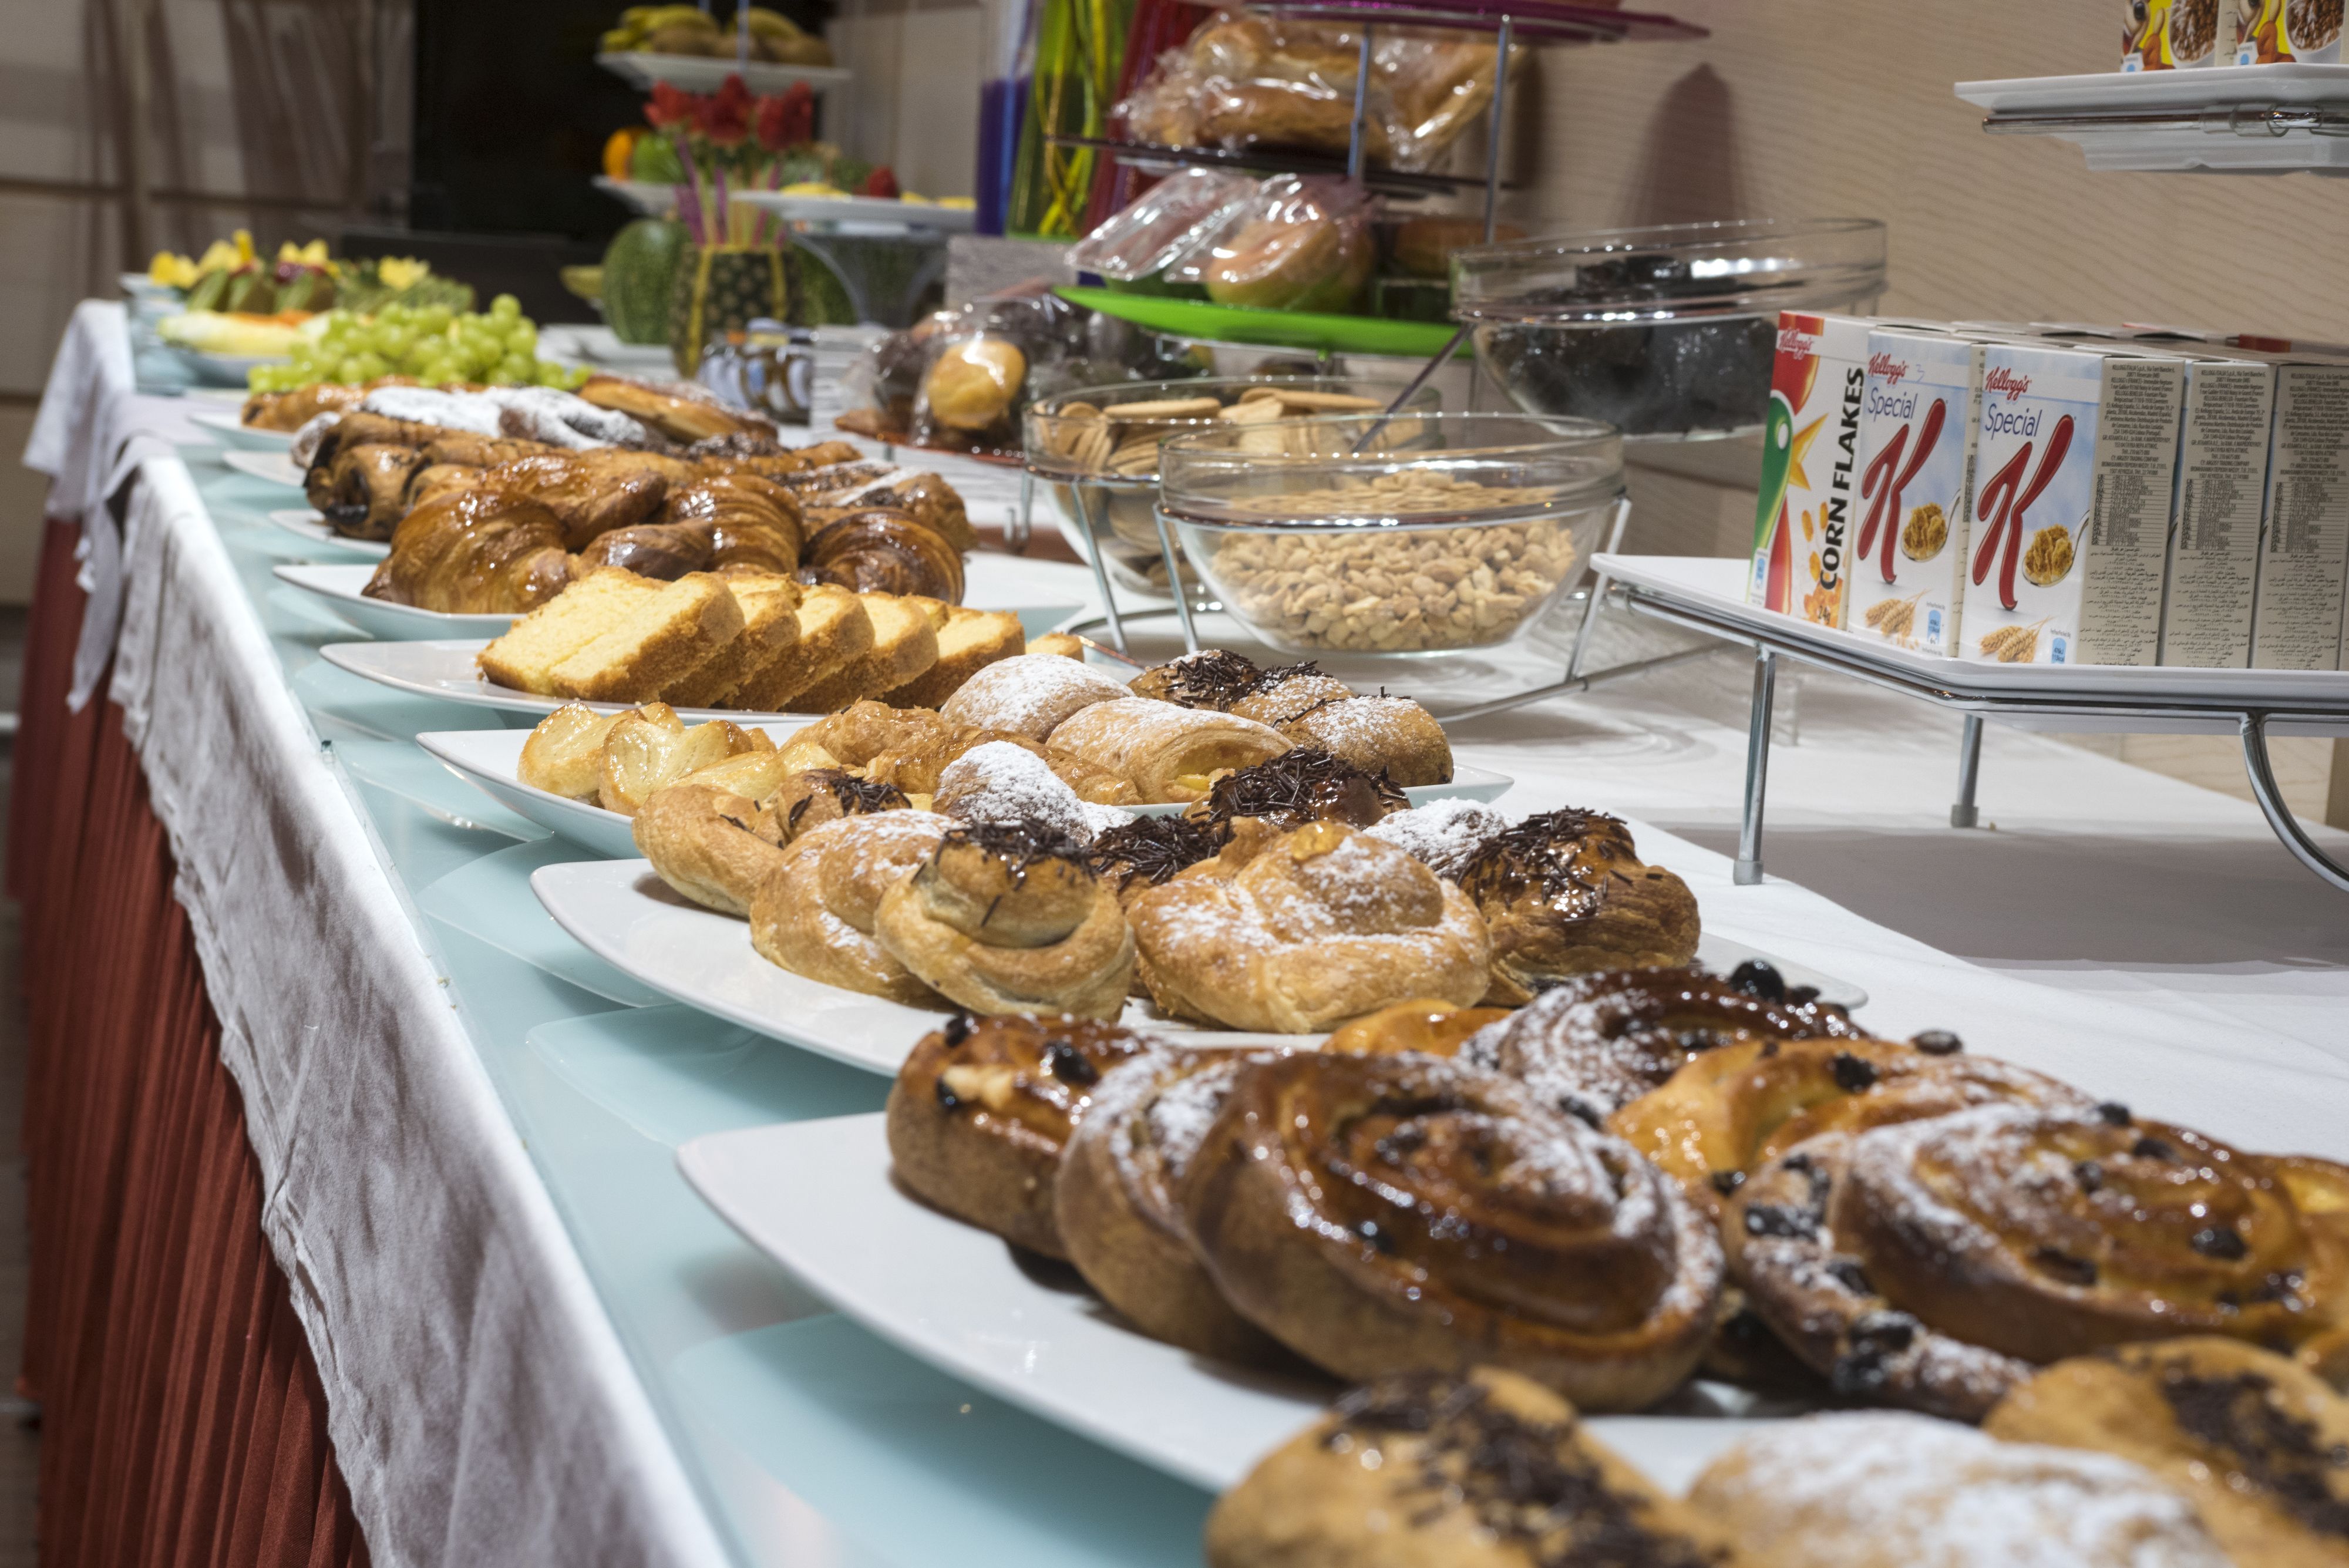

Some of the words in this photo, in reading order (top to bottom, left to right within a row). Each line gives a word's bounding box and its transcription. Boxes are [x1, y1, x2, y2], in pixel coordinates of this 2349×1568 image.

[1779, 328, 1813, 359] Kellogg's
[1868, 352, 1907, 385] Kellogg's
[1985, 366, 2030, 401] Kellogg's
[1868, 387, 1918, 422] Special
[1985, 403, 2042, 440] Special
[1832, 368, 1864, 490] FLAKES
[1857, 398, 1946, 584] K
[1973, 414, 2074, 611] K
[1820, 497, 1847, 590] CORN
